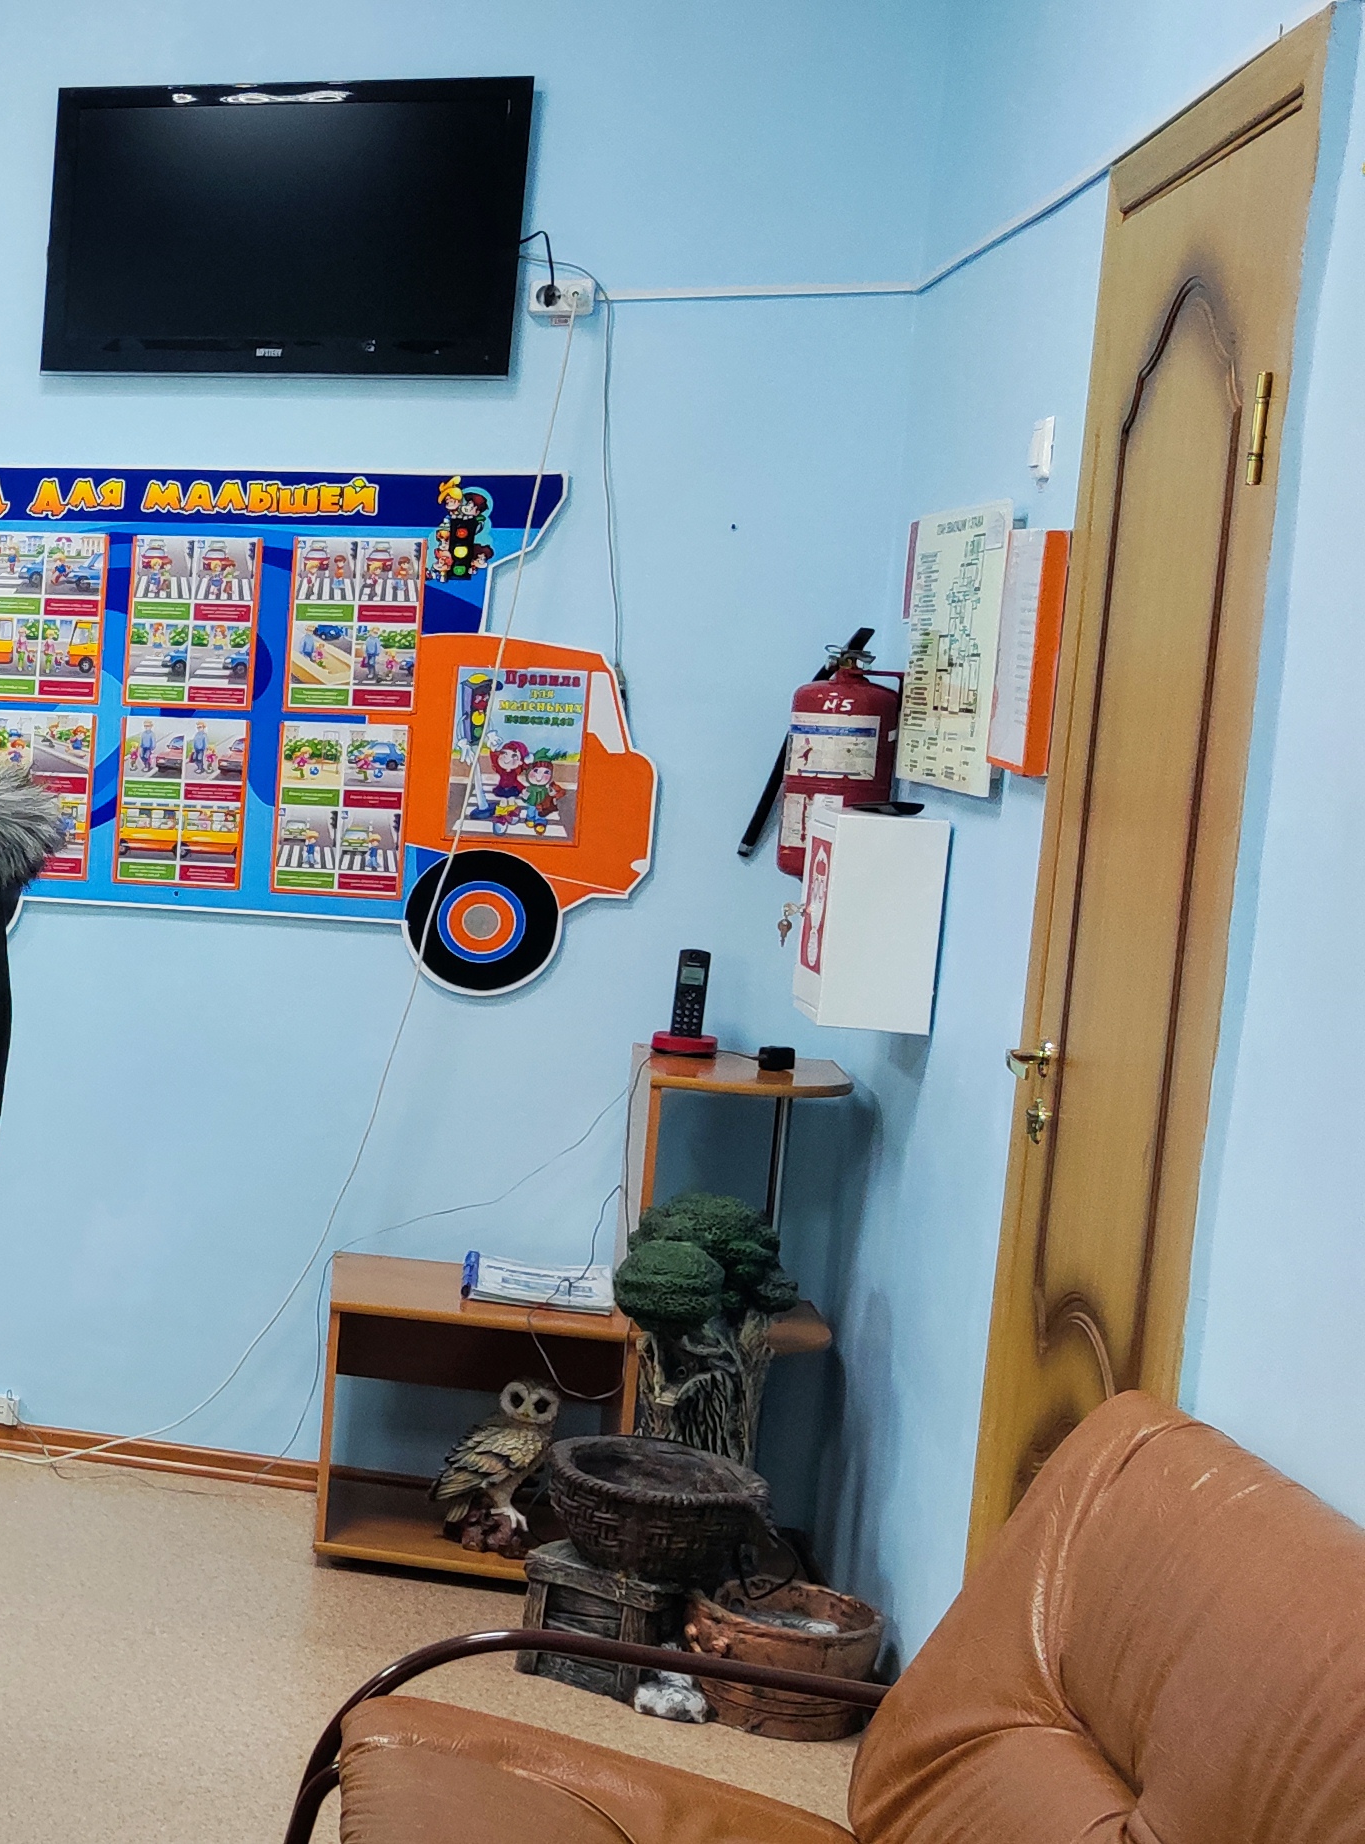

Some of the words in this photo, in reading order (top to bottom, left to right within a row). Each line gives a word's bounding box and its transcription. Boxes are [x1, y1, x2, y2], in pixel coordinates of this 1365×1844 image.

[26, 477, 126, 519] ДЛЯ
[142, 477, 378, 516] МАЛЫШЕЙ
[504, 670, 581, 688] Правила
[530, 689, 555, 699] для
[498, 700, 583, 714] маленьких
